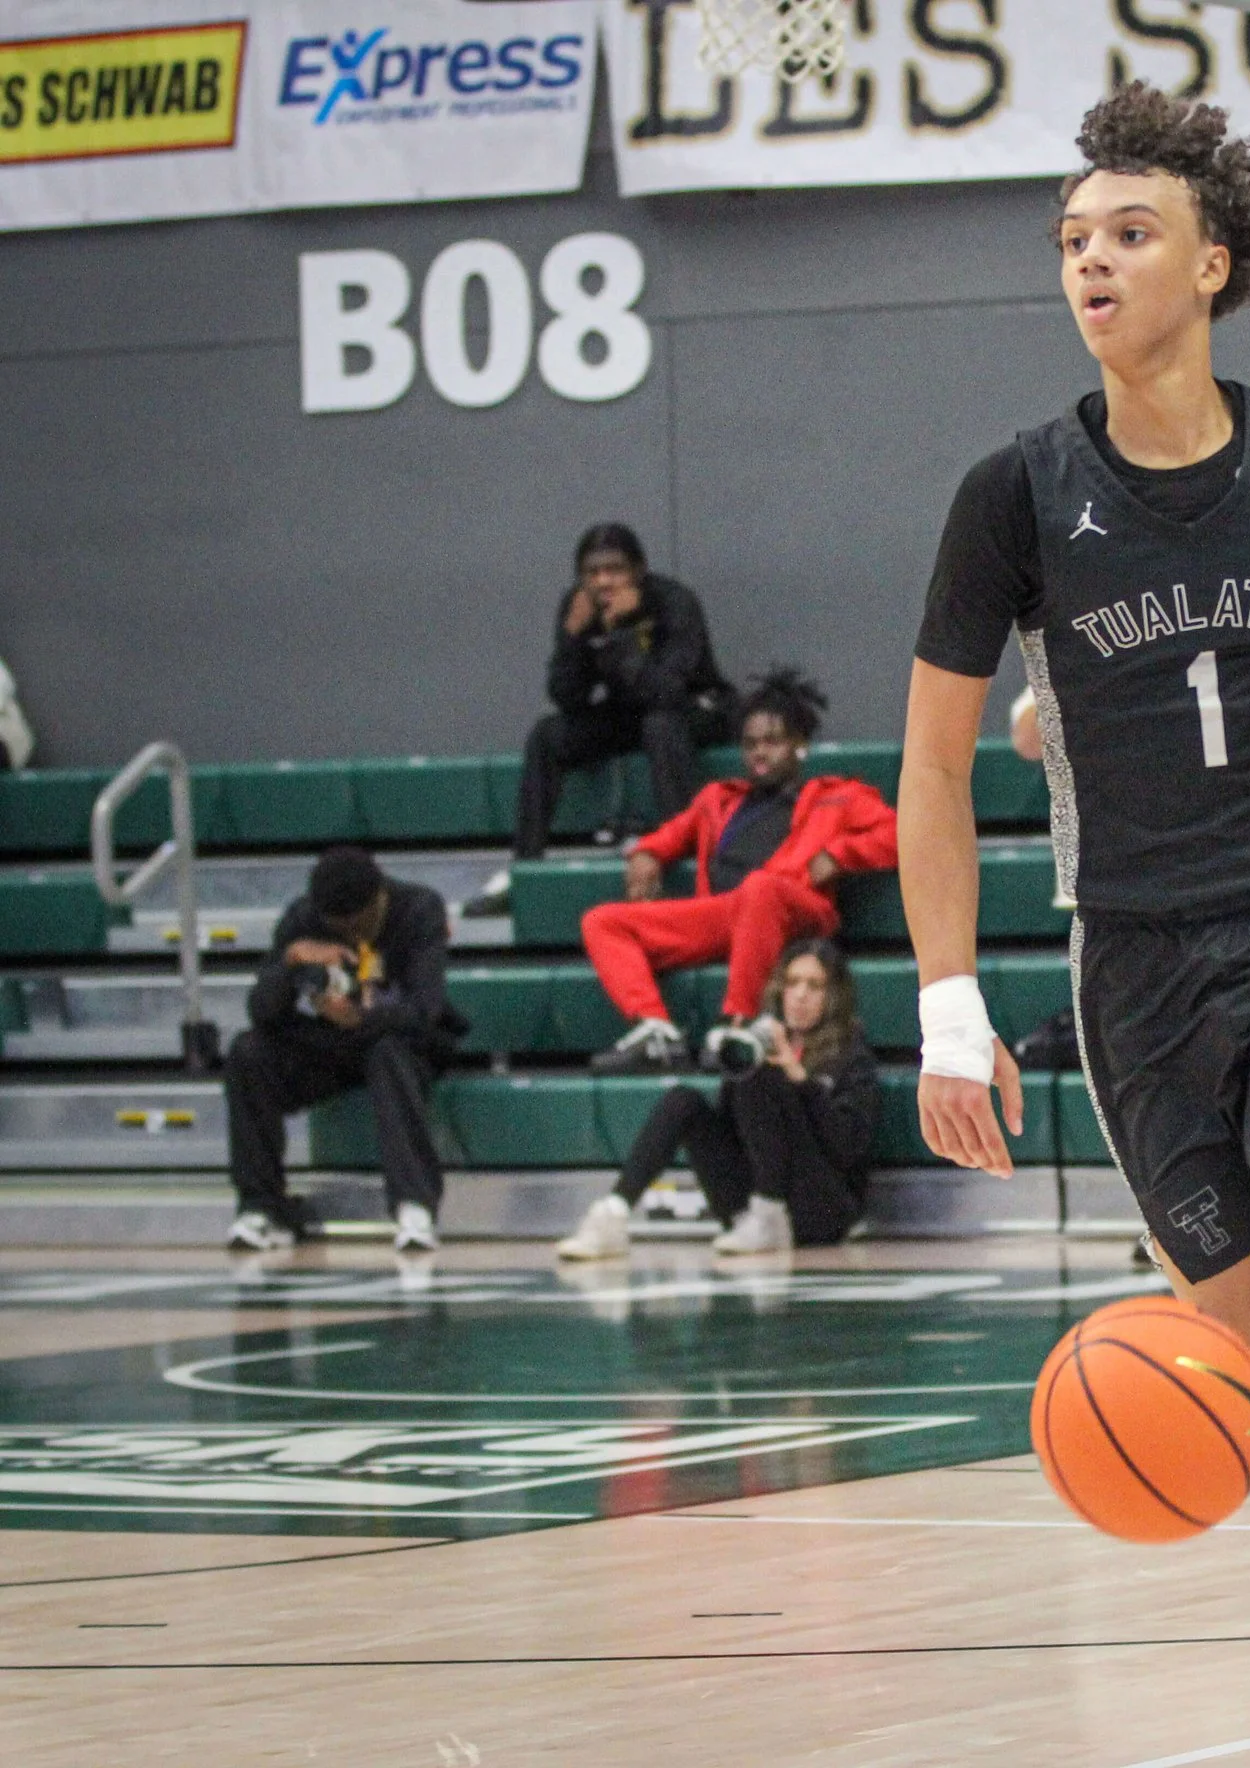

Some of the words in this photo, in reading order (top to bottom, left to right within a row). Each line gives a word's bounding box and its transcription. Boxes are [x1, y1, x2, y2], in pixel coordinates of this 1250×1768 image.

[37, 56, 222, 128] SCHWAB
[300, 232, 653, 415] B08
[1187, 650, 1229, 768] 1
